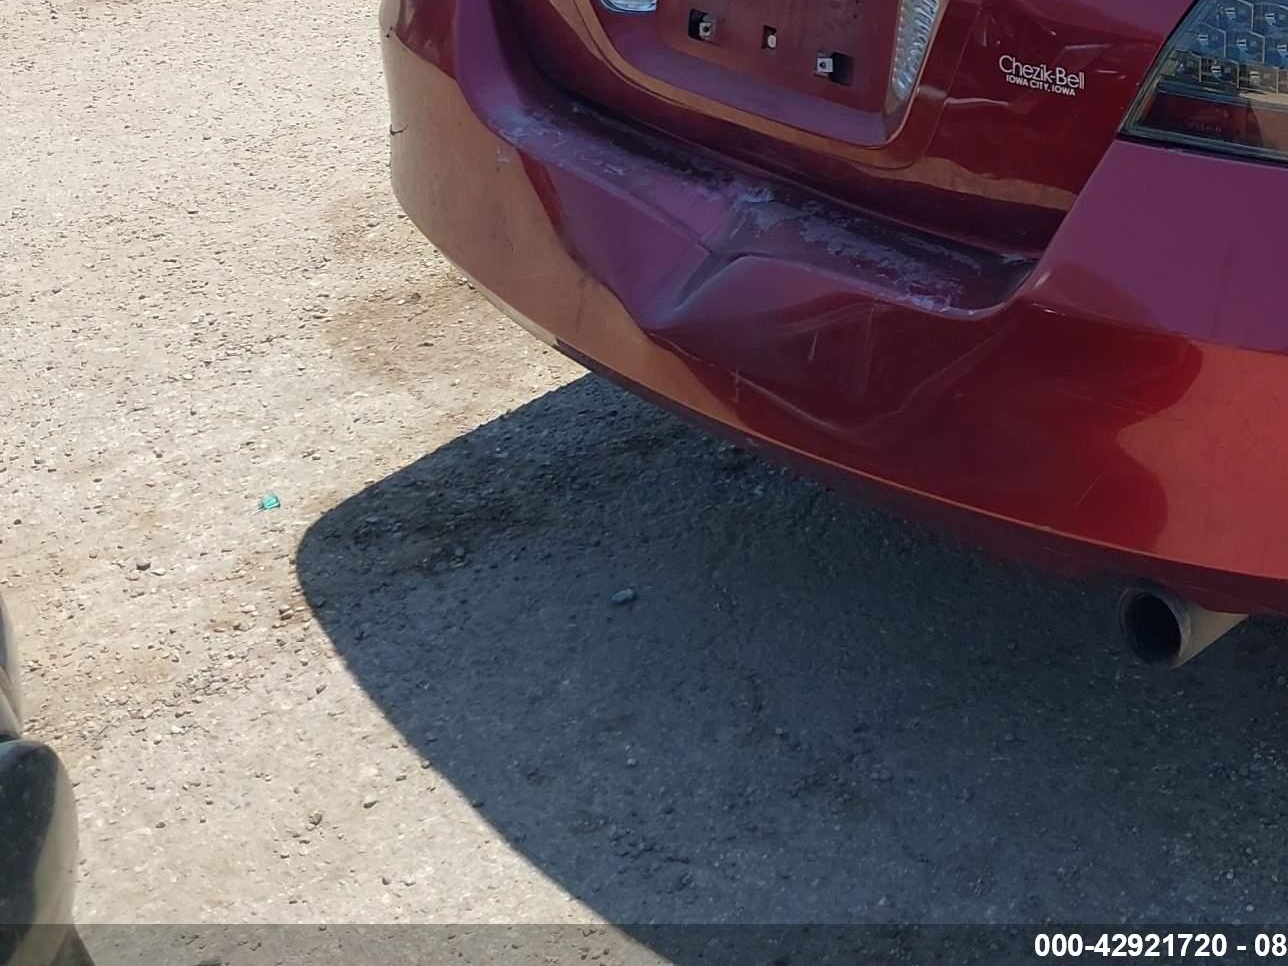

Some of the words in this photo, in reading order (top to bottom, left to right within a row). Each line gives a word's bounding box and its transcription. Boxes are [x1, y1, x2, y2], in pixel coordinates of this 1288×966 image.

[999, 55, 1085, 89] Chezik-Bell
[1006, 74, 1029, 86] IOWA
[1029, 79, 1051, 92] CITY,
[1051, 85, 1076, 97] IOWA
